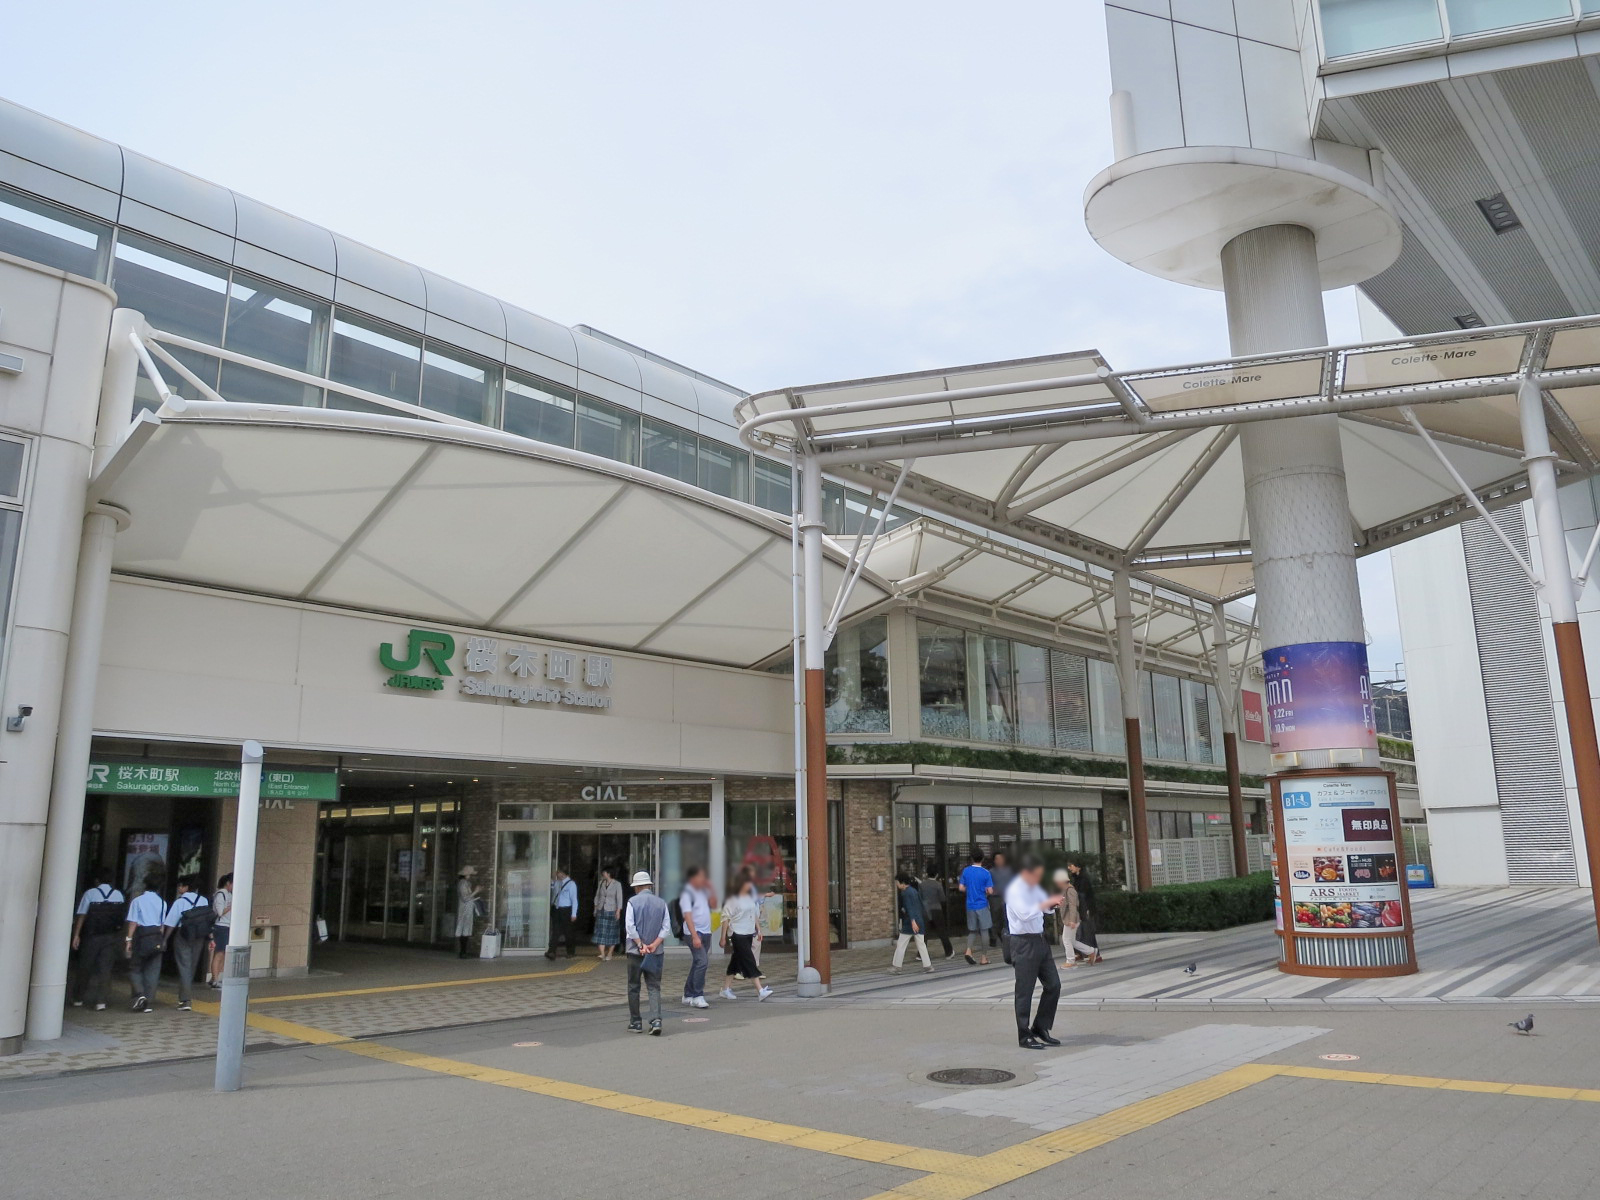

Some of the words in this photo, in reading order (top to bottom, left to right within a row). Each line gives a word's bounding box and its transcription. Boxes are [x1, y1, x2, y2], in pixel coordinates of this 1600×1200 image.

[379, 629, 456, 677] JR
[464, 637, 614, 688] 桜木町駅
[563, 688, 612, 708] Station
[118, 765, 180, 782] 桜木町駅
[268, 773, 294, 784] (東口)
[170, 783, 199, 792] Station
[581, 785, 628, 801] CIAL
[1285, 794, 1296, 807] B1
[1351, 819, 1388, 831] 無印良品
[1309, 888, 1336, 897] ARS
